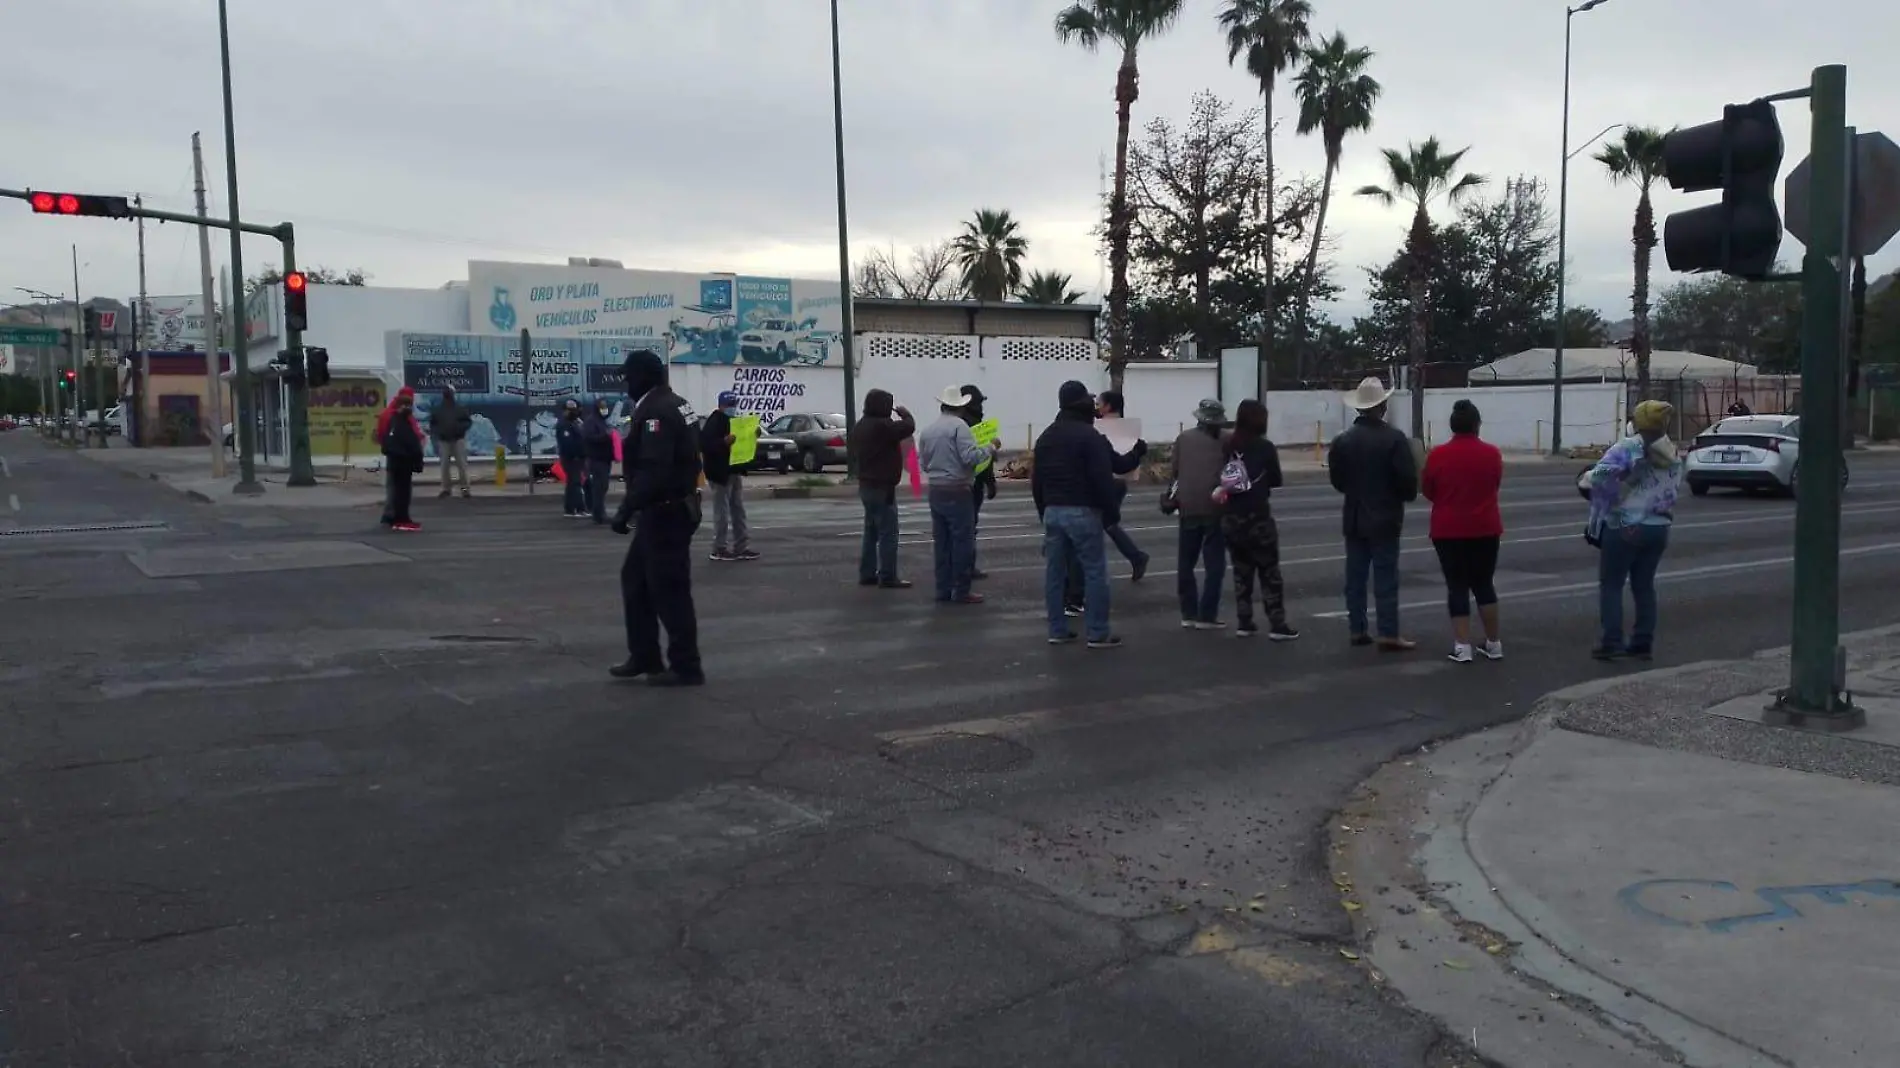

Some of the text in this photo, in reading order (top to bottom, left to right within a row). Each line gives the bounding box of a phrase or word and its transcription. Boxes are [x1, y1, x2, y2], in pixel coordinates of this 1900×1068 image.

[530, 282, 599, 301] ORO Y PLATA
[603, 292, 675, 312] ELECTRÓNICA
[536, 308, 597, 328] VEHÍCULOS
[509, 349, 569, 358] REAURANT
[497, 361, 579, 374] LOS MAGOS
[734, 368, 786, 382] CARROS
[308, 386, 380, 408] MPEÑO
[731, 383, 806, 396] ELECTRICOS
